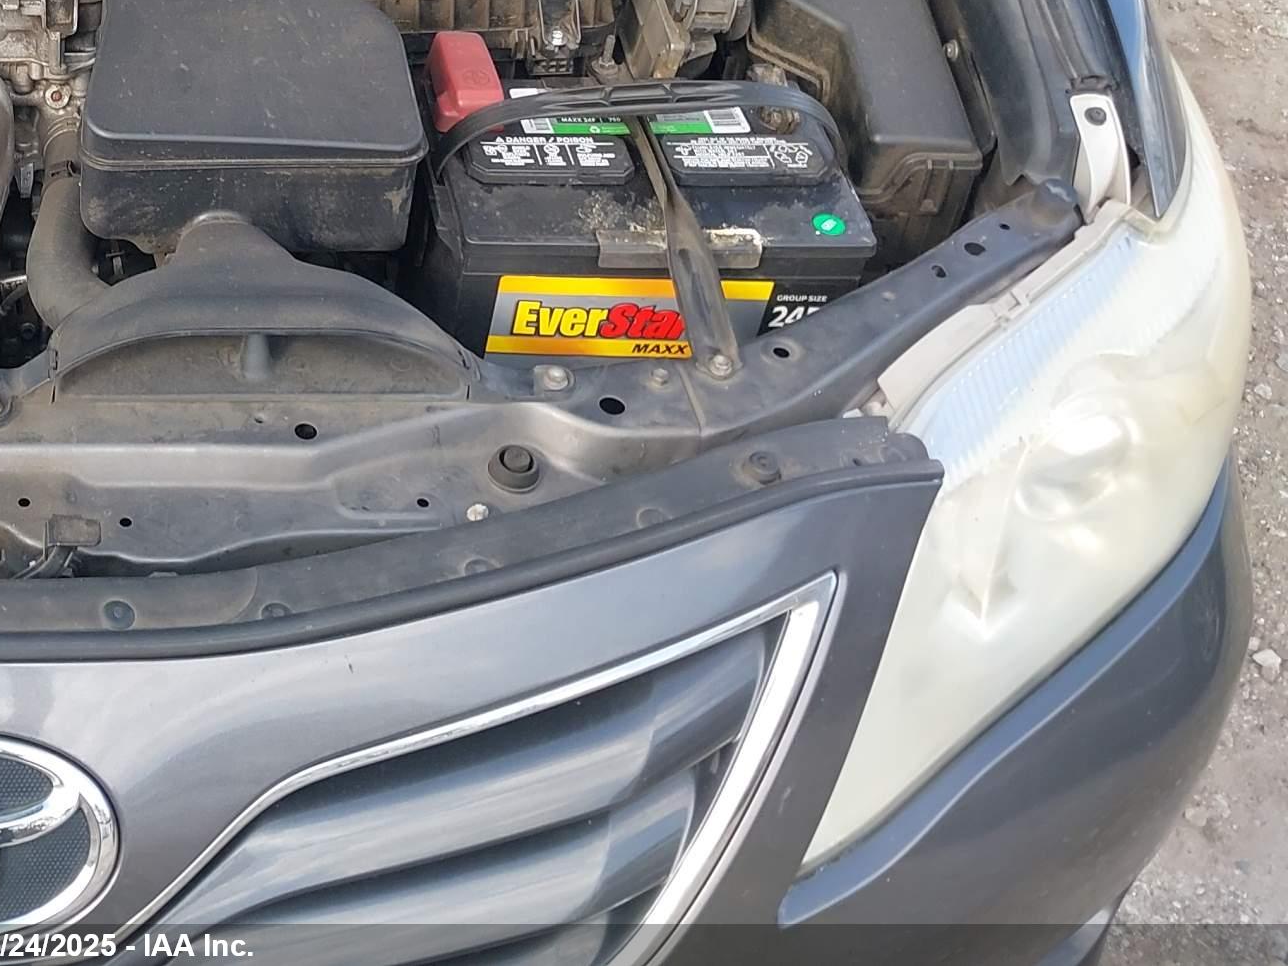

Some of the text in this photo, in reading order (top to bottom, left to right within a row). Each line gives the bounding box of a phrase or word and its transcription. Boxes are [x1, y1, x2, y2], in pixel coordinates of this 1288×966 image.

[506, 136, 546, 144] DANGER
[556, 136, 594, 144] POISON
[776, 294, 828, 303] GROUP SIZE
[631, 343, 689, 355] MAXX
